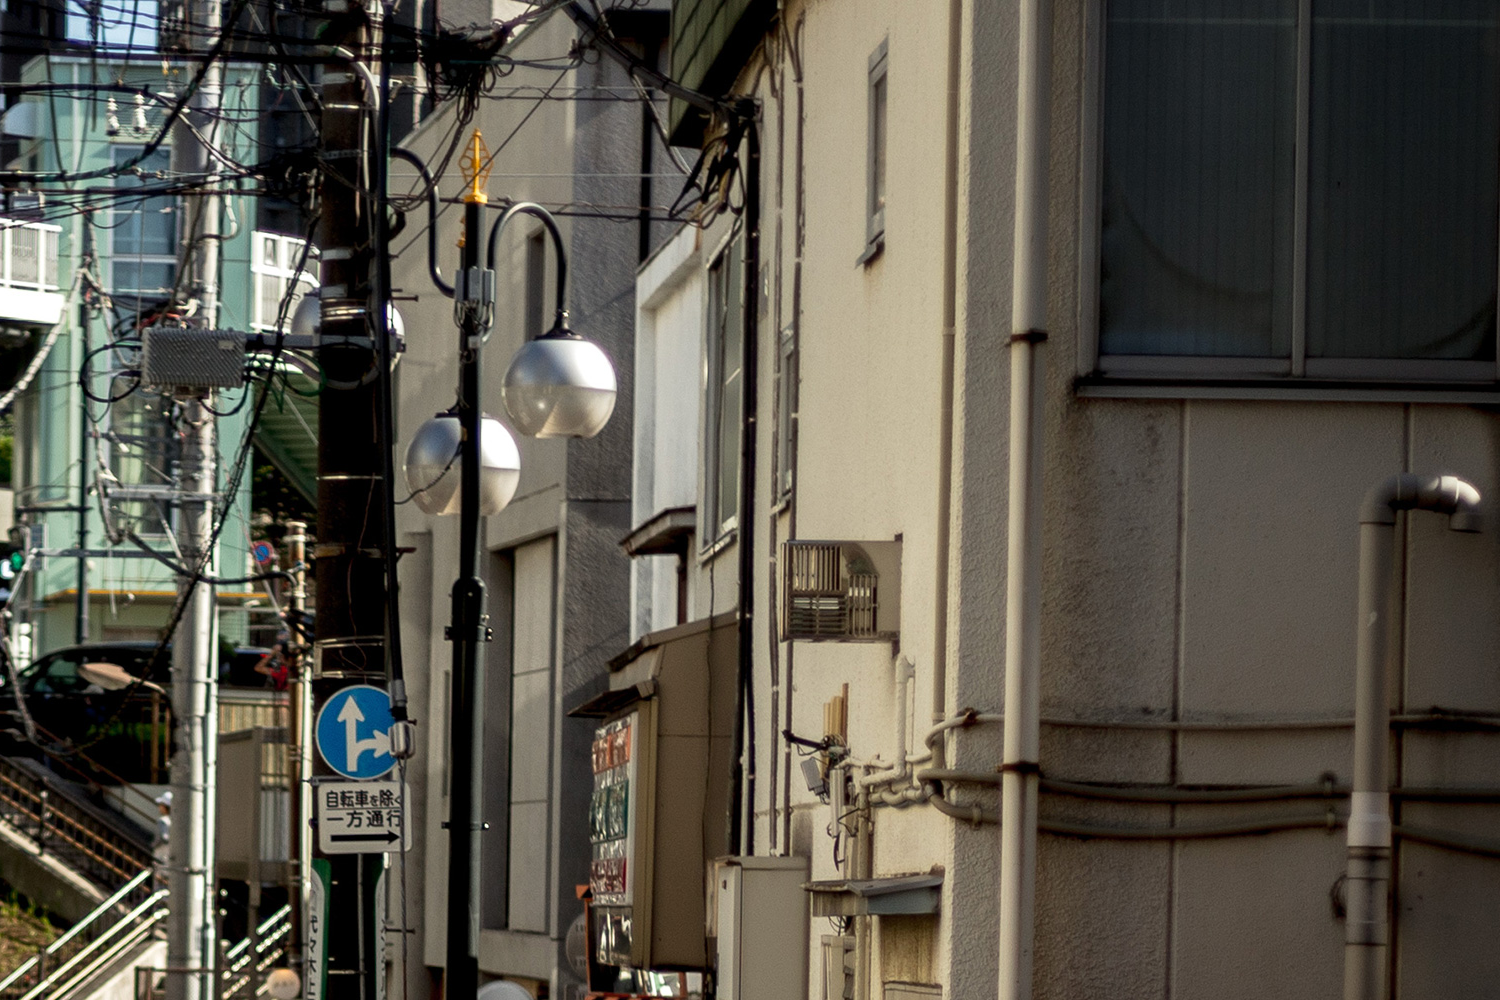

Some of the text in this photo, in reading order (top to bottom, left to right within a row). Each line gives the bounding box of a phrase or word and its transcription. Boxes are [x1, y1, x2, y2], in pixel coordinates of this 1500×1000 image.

[326, 789, 401, 808] 自転車を除く
[326, 809, 401, 828] 一方通行
